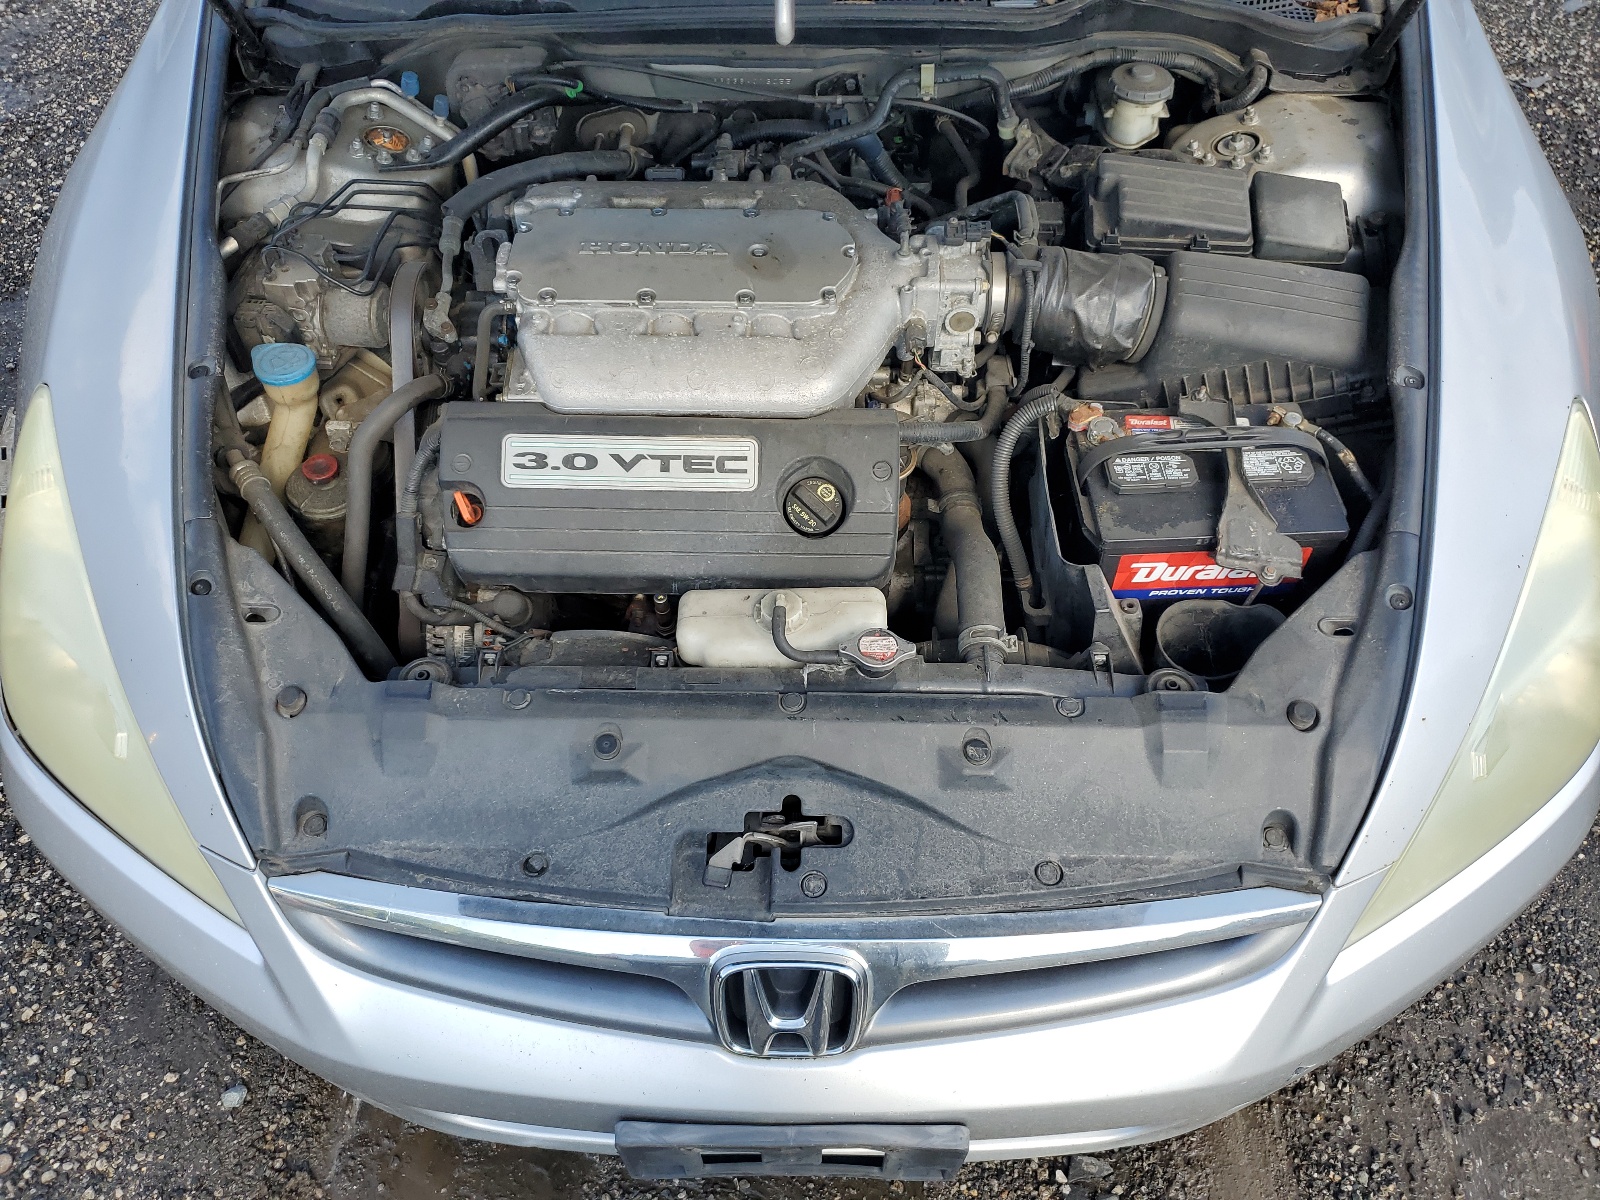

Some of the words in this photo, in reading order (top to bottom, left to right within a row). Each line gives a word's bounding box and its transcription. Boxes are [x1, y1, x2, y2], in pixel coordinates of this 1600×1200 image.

[579, 241, 729, 255] HONDA
[1129, 418, 1168, 426] Duralast
[512, 451, 599, 471] 3.0
[608, 453, 748, 474] VTEC
[1130, 562, 1257, 583] Durala
[1148, 588, 1208, 597] PROVEN
